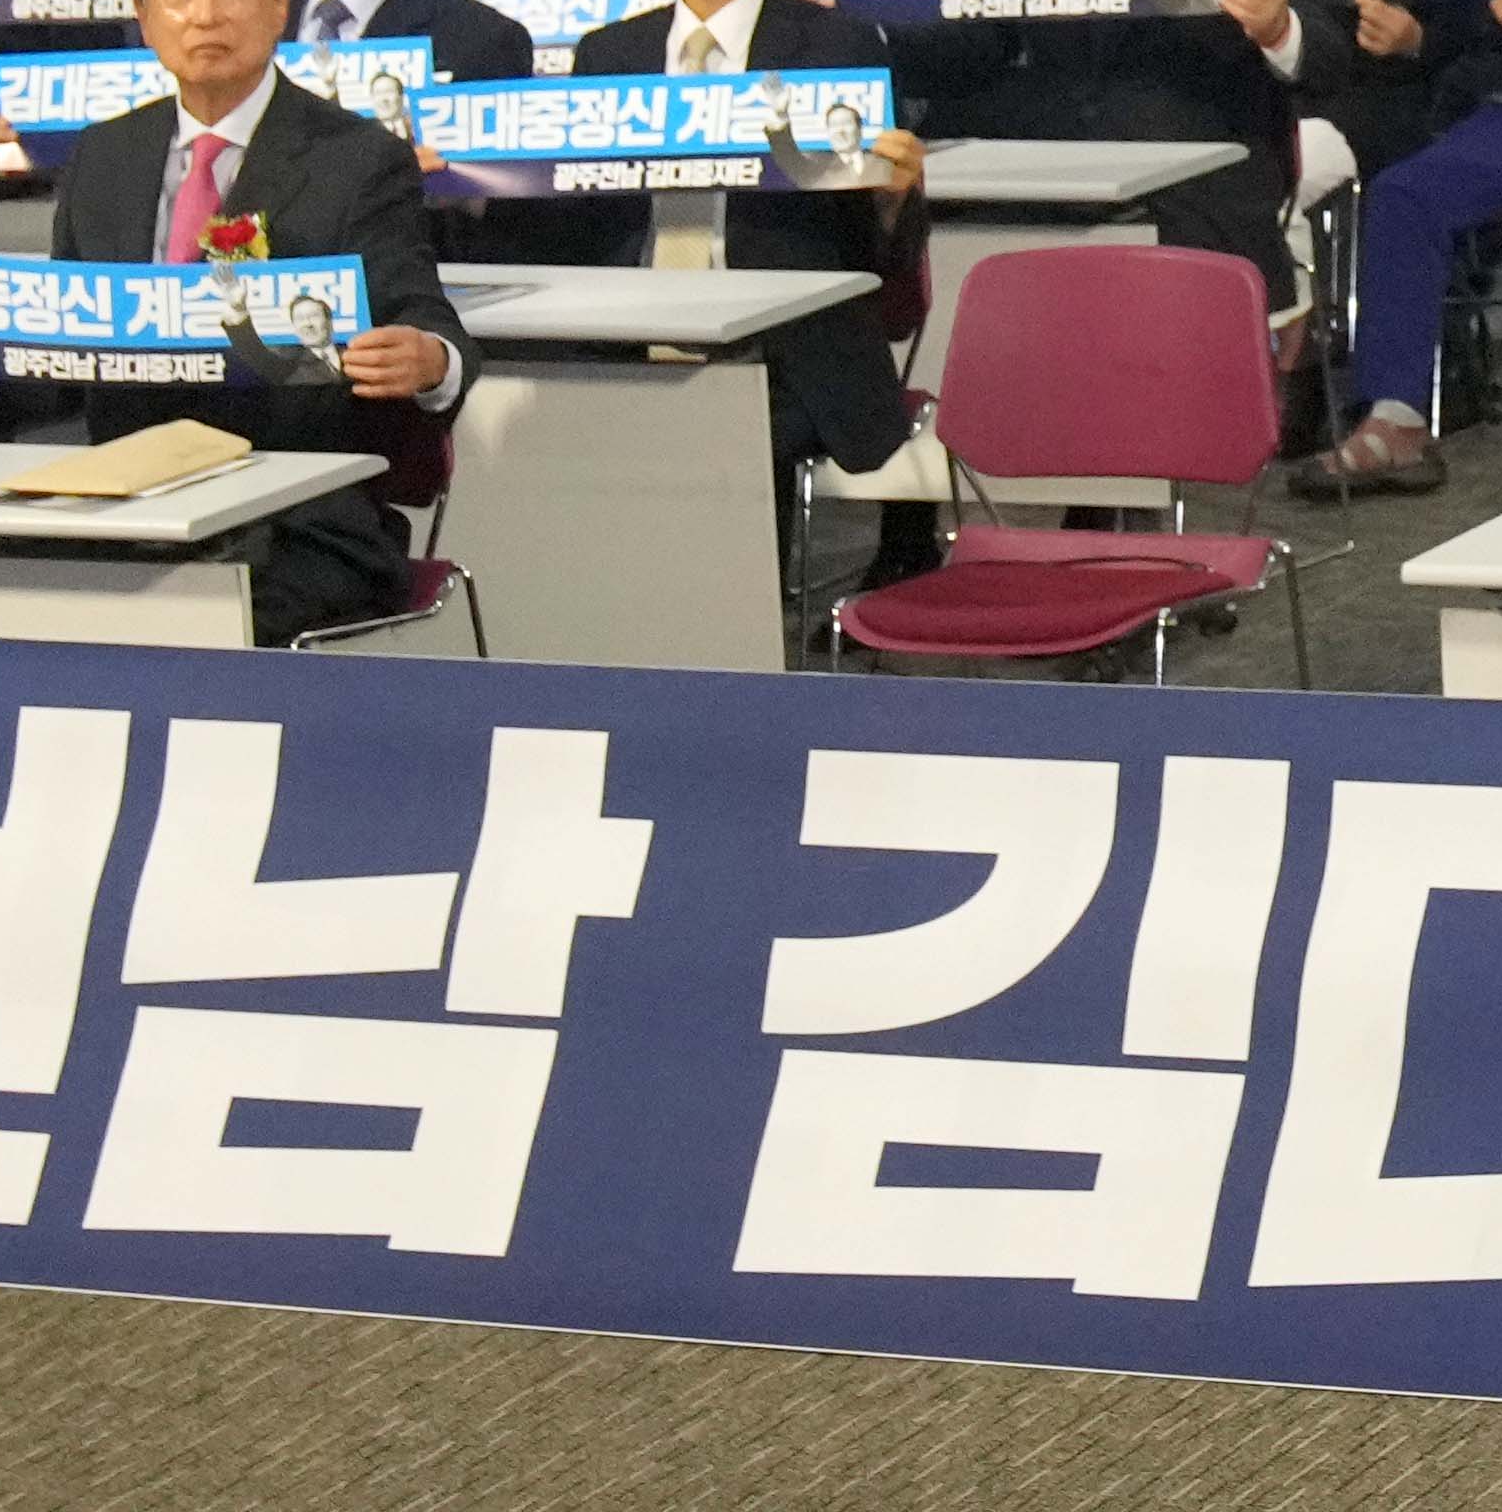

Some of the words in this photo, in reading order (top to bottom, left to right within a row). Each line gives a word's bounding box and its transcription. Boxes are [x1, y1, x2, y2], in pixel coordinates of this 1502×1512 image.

[421, 92, 665, 151] 김대중정신
[677, 79, 881, 143] 계승발전
[646, 158, 764, 186] 김대중재단
[127, 264, 358, 339] 계승발전
[3, 348, 94, 381] 광주전남
[99, 350, 226, 384] 김대중재단
